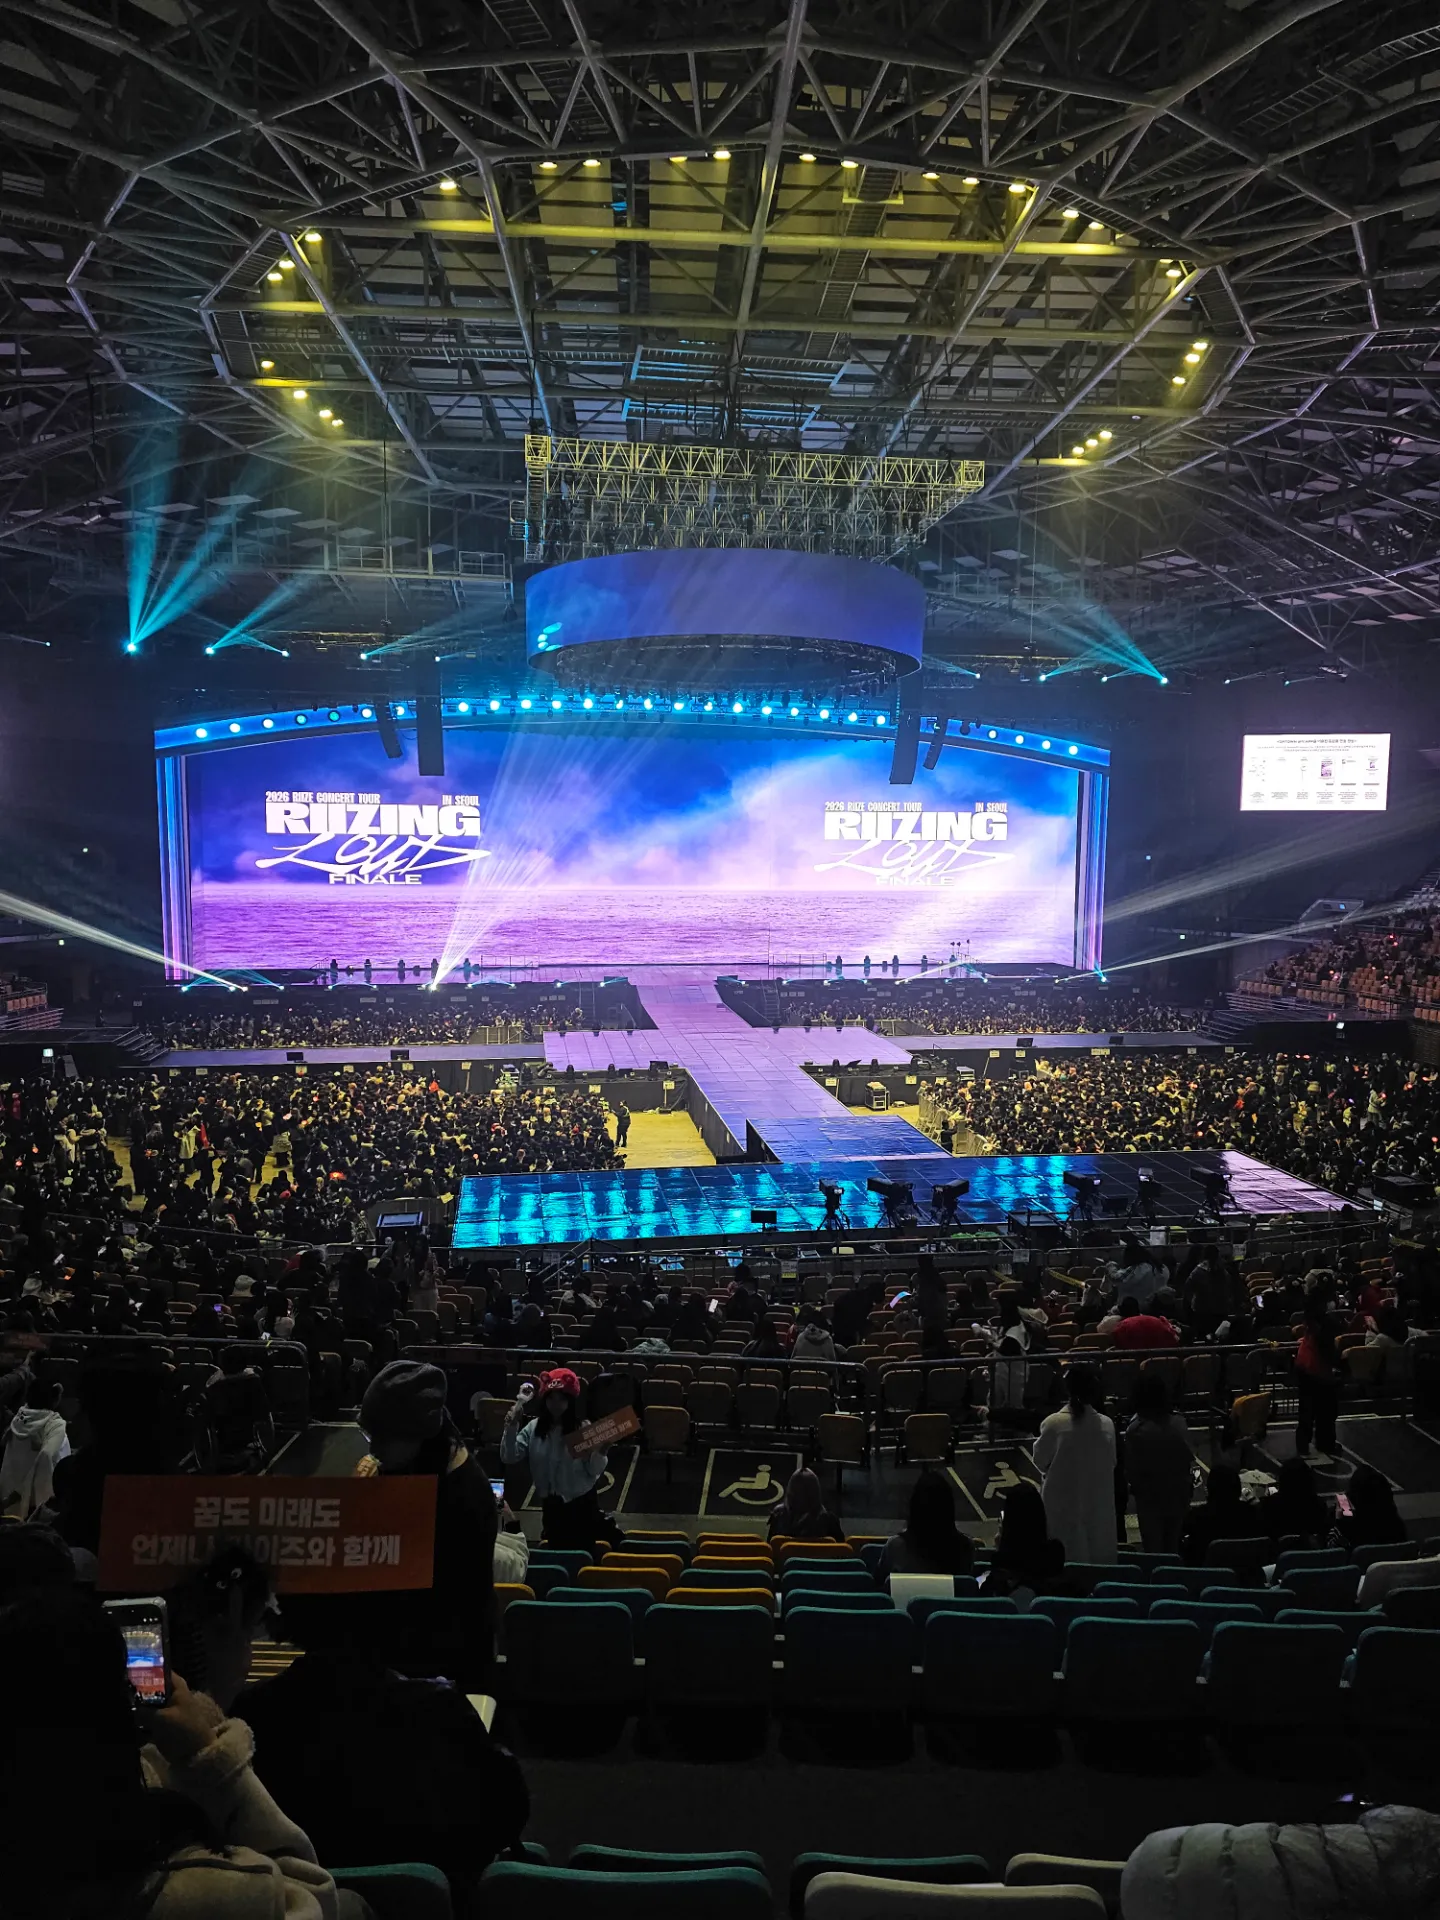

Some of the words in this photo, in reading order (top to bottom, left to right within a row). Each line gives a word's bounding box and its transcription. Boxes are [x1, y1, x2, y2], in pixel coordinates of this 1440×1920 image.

[265, 791, 289, 803] 2026
[316, 792, 355, 804] CONCERT
[358, 793, 381, 804] TOUR
[442, 794, 452, 806] IN
[454, 795, 480, 807] SEOUL
[825, 801, 845, 812] 2026
[868, 802, 900, 812] CONCERT
[903, 802, 922, 812] TOUR
[975, 802, 984, 812] IN
[987, 802, 1008, 813] SEOUL
[265, 802, 481, 837] RIIZING
[824, 811, 1008, 841] RIIZING
[329, 874, 422, 885] FINALE
[876, 876, 955, 886] FINALE
[193, 1496, 250, 1528] 꿈도
[258, 1497, 341, 1528] 미래도
[226, 1534, 336, 1567] 이즈와
[343, 1535, 400, 1567] 함께
